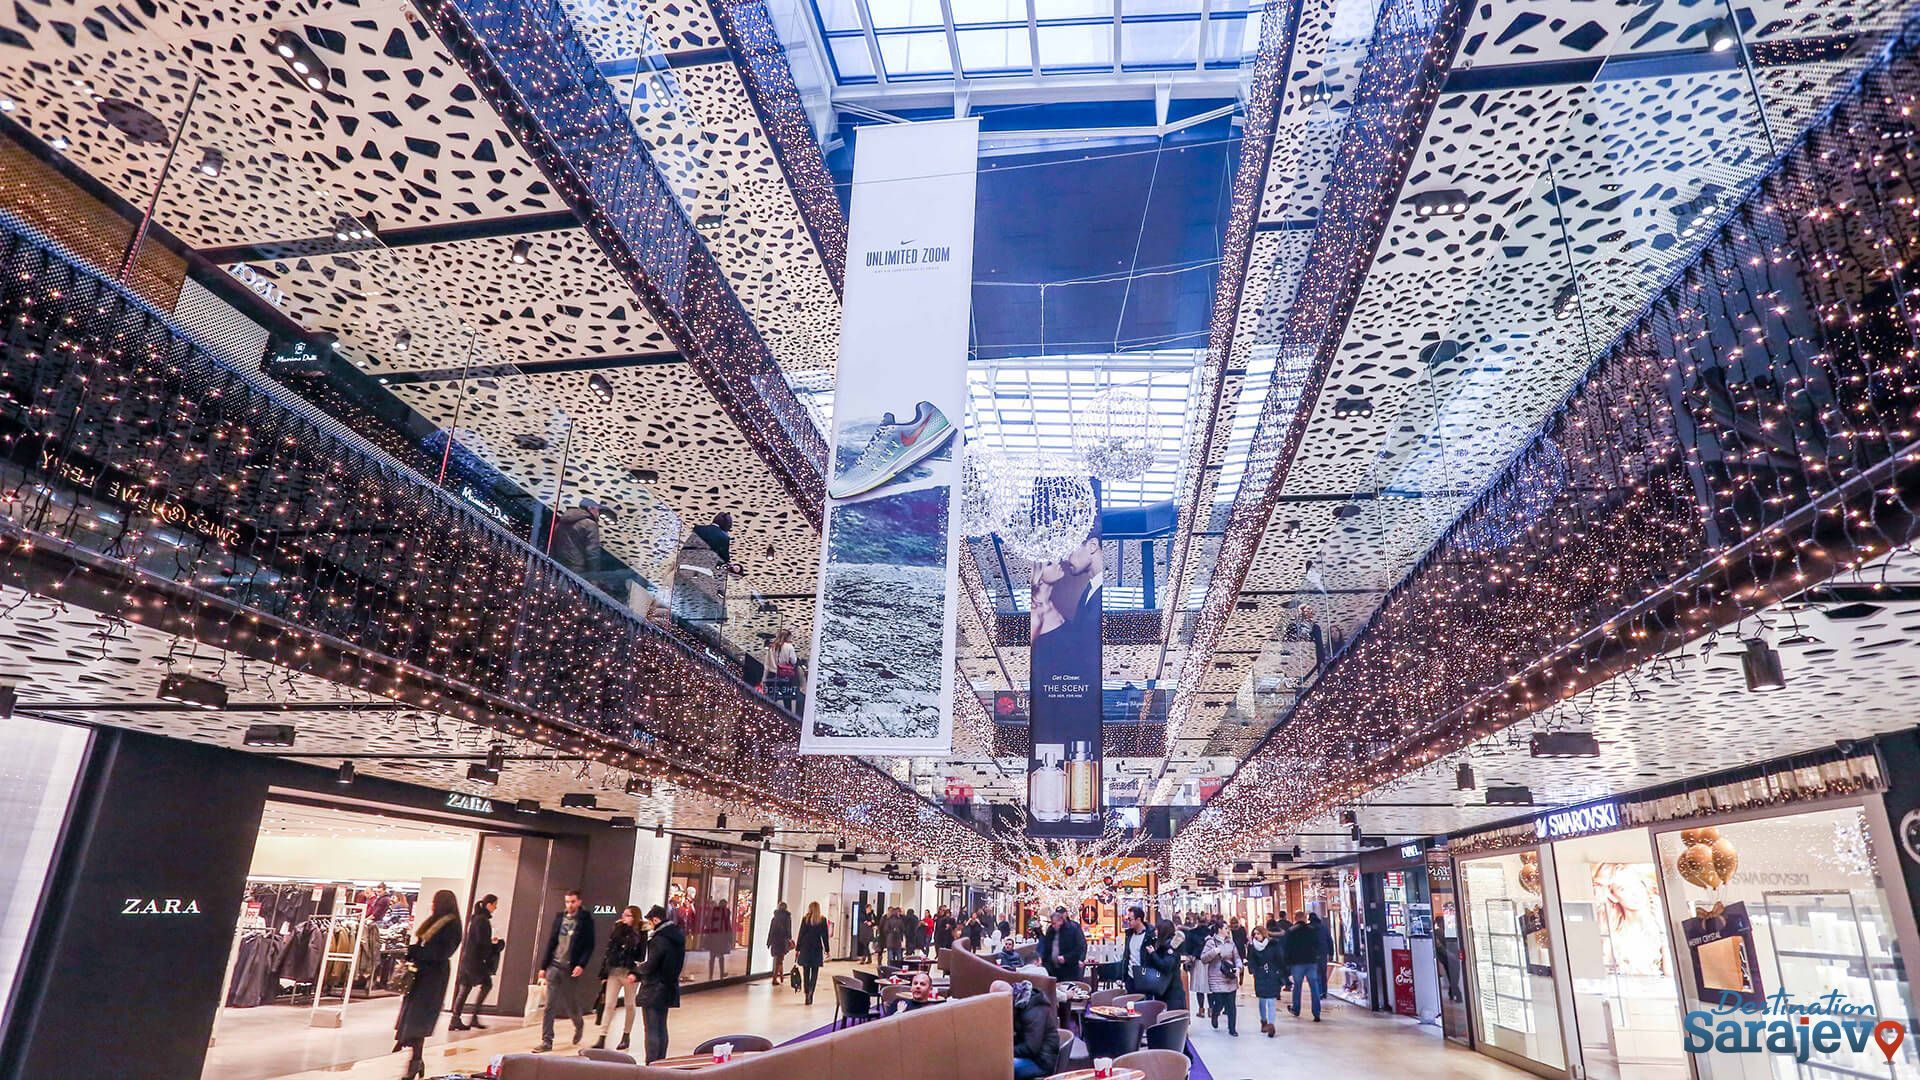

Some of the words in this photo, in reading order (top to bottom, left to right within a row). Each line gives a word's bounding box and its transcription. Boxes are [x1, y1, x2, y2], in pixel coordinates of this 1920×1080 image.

[866, 248, 918, 267] UNLIMITED
[921, 246, 950, 263] ZOOM
[1043, 684, 1060, 692] THE
[1061, 684, 1089, 692] SCENT
[446, 792, 494, 813] ZARA
[1548, 802, 1618, 837] SWAROVSKI
[1732, 872, 1810, 886] SWAROVSKI
[121, 898, 201, 915] ZARA
[593, 905, 617, 914] ZARA
